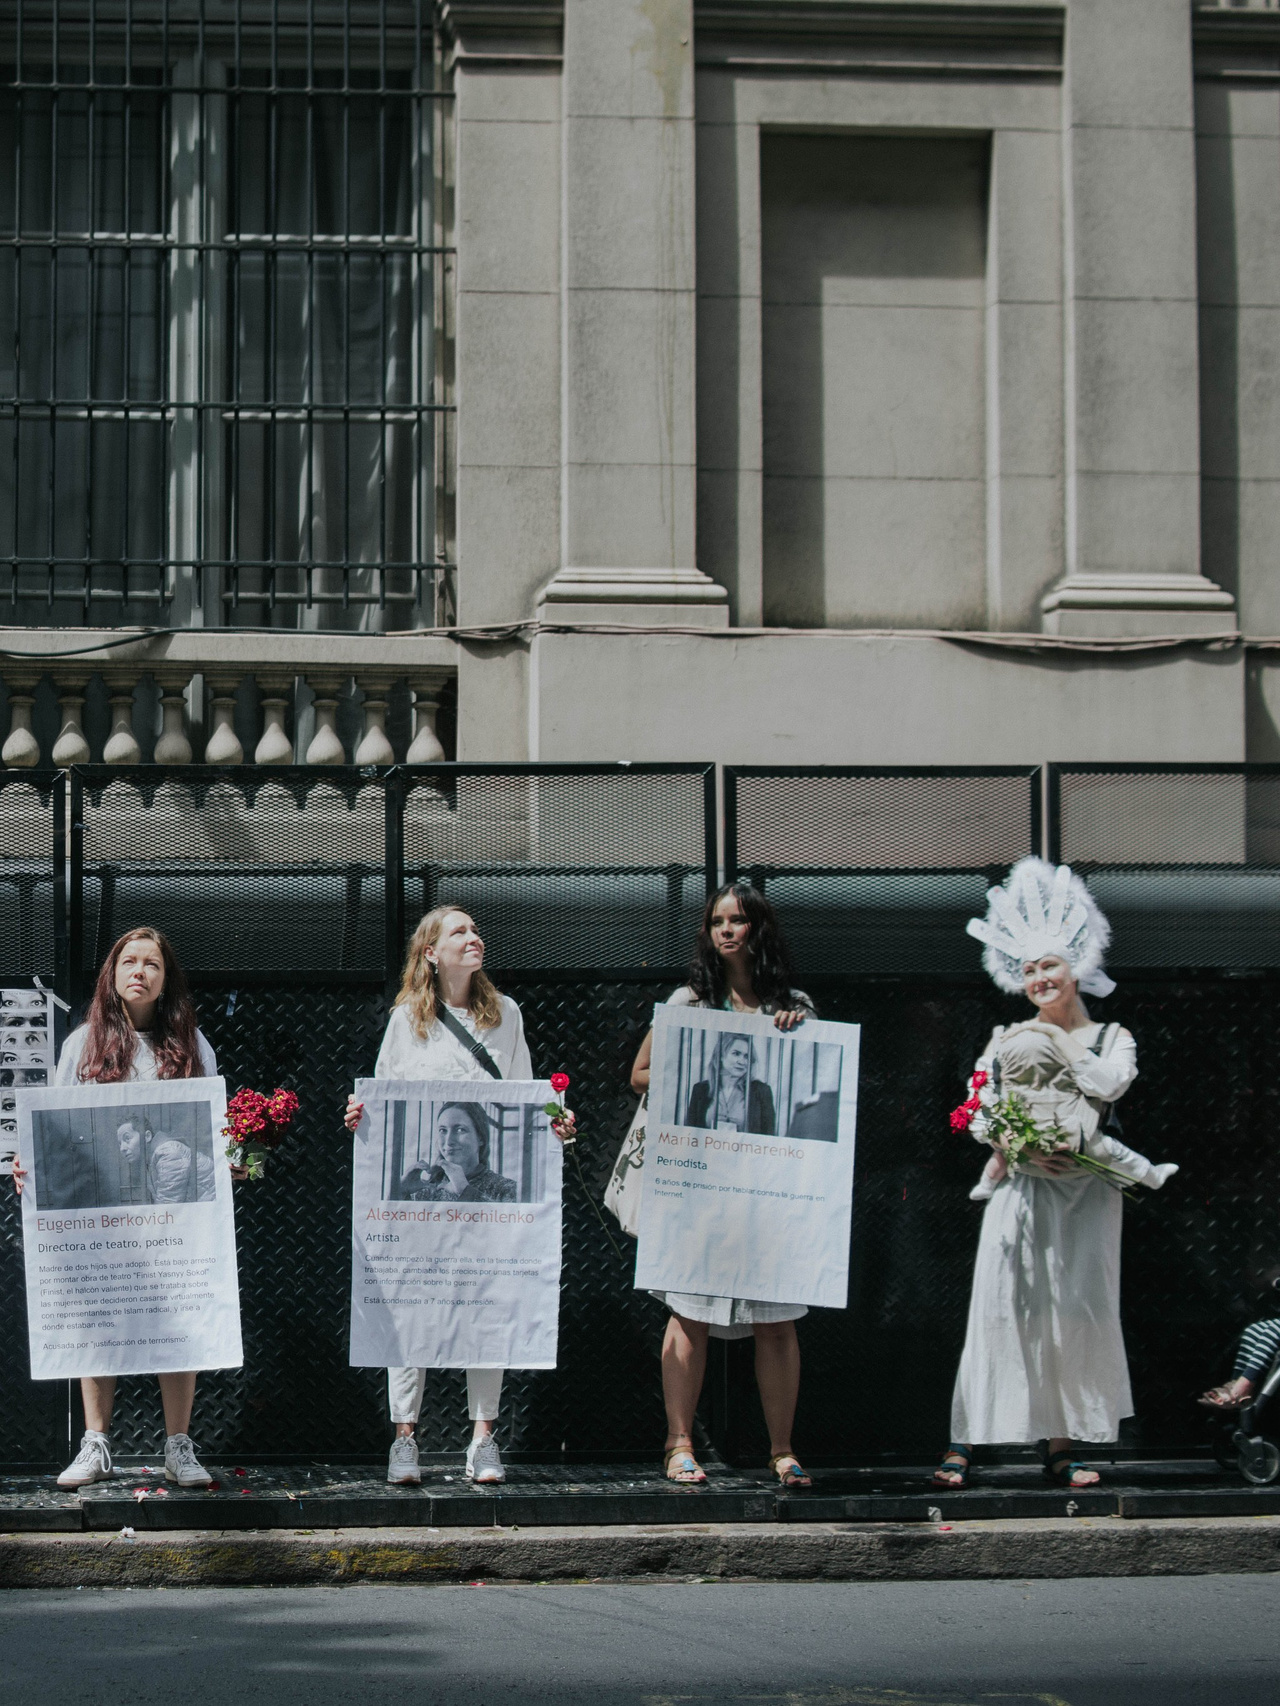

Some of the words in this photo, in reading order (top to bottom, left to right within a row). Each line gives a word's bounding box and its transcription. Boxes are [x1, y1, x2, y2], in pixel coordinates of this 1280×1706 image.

[658, 1132, 700, 1147] María
[703, 1136, 805, 1159] Ponomarenko
[657, 1155, 707, 1169] Periodista
[681, 1180, 691, 1188] de
[781, 1190, 789, 1198] la
[366, 1208, 442, 1222] Alexandra
[445, 1209, 534, 1223] Skochilenko
[37, 1215, 98, 1234] Eugenia
[101, 1211, 174, 1228] Berkovich
[38, 1242, 87, 1252] Directora
[89, 1240, 104, 1250] de
[106, 1239, 141, 1249] teatro,
[143, 1236, 183, 1250] poetisa
[365, 1233, 400, 1242] Artista
[75, 1263, 89, 1271] dos
[90, 1262, 108, 1271] hijos
[109, 1263, 124, 1271] que
[173, 1258, 189, 1267] bajo
[190, 1257, 216, 1265] arresto
[80, 1274, 98, 1282] obra
[101, 1284, 132, 1293] valiente)
[160, 1281, 187, 1289] trataba
[188, 1280, 208, 1288] sobre
[53, 1299, 83, 1308] mujeres
[84, 1299, 98, 1307] que
[100, 1296, 138, 1304] decidieron
[456, 1297, 466, 1305] de
[56, 1309, 111, 1319] representantes
[124, 1307, 144, 1315] Islam
[66, 1321, 96, 1329] estaban
[43, 1341, 75, 1350] Acusada
[76, 1342, 89, 1350] por
